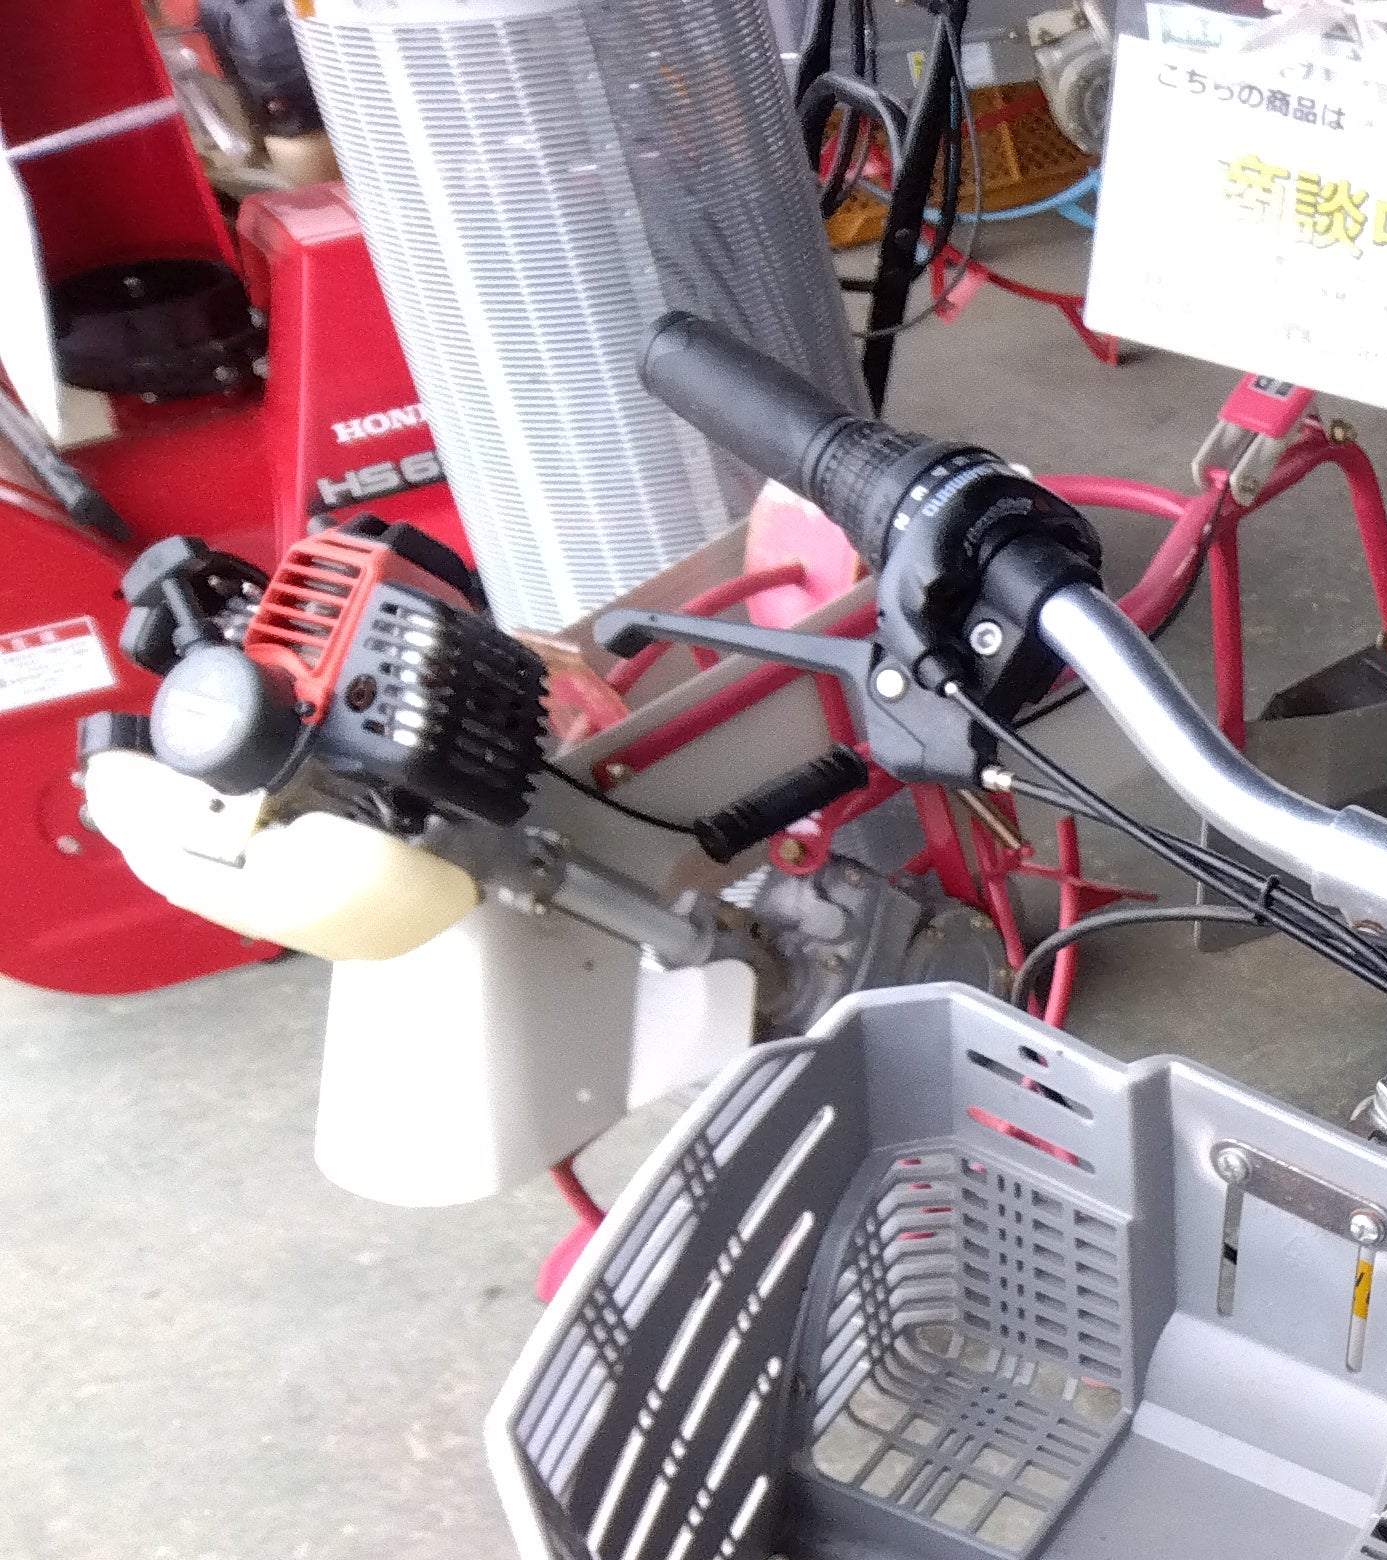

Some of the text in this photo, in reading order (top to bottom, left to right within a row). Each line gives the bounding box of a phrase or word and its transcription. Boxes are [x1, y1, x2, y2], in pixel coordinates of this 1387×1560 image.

[1157, 63, 1346, 131] こちらの商品は
